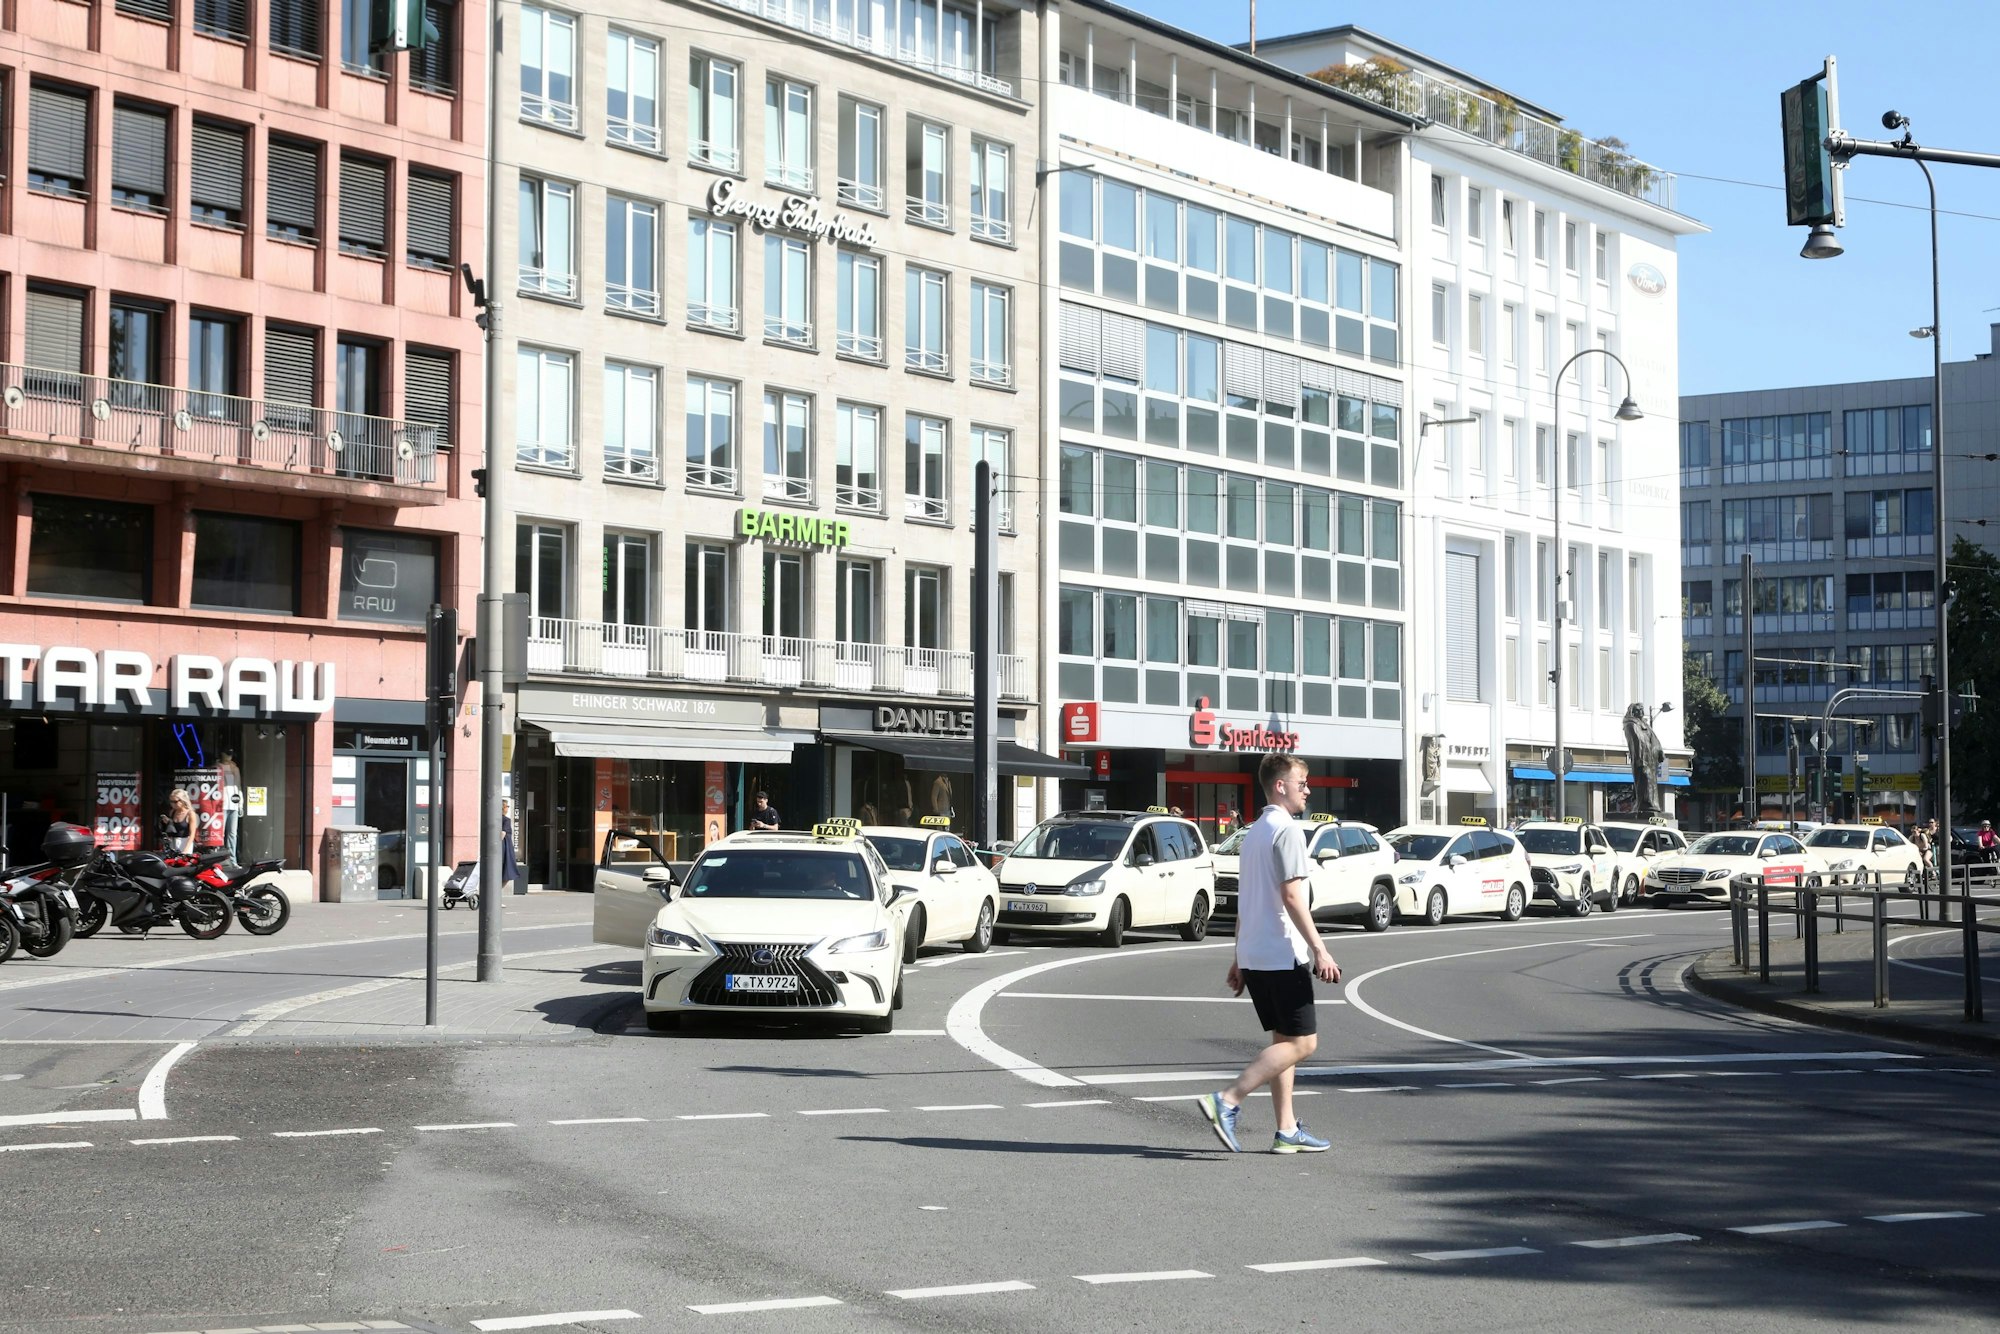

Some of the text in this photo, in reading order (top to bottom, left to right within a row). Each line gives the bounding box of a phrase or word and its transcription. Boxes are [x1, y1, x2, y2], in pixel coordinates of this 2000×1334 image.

[712, 176, 779, 229] Georg
[741, 508, 851, 548] BARMER
[353, 595, 396, 612] RAW
[171, 653, 336, 713] RAW
[572, 694, 716, 715] EHINGER SCHWARZ 1876
[878, 705, 975, 731] DANIELS
[364, 735, 398, 745] Neumarkt
[1222, 721, 1300, 752] Sparkasse
[96, 787, 139, 805] 30%
[96, 816, 140, 834] 50%
[820, 825, 847, 836] TAXI
[831, 818, 854, 827] TAXI
[733, 976, 741, 988] K
[749, 977, 764, 988] TX
[767, 977, 796, 988] 9724
